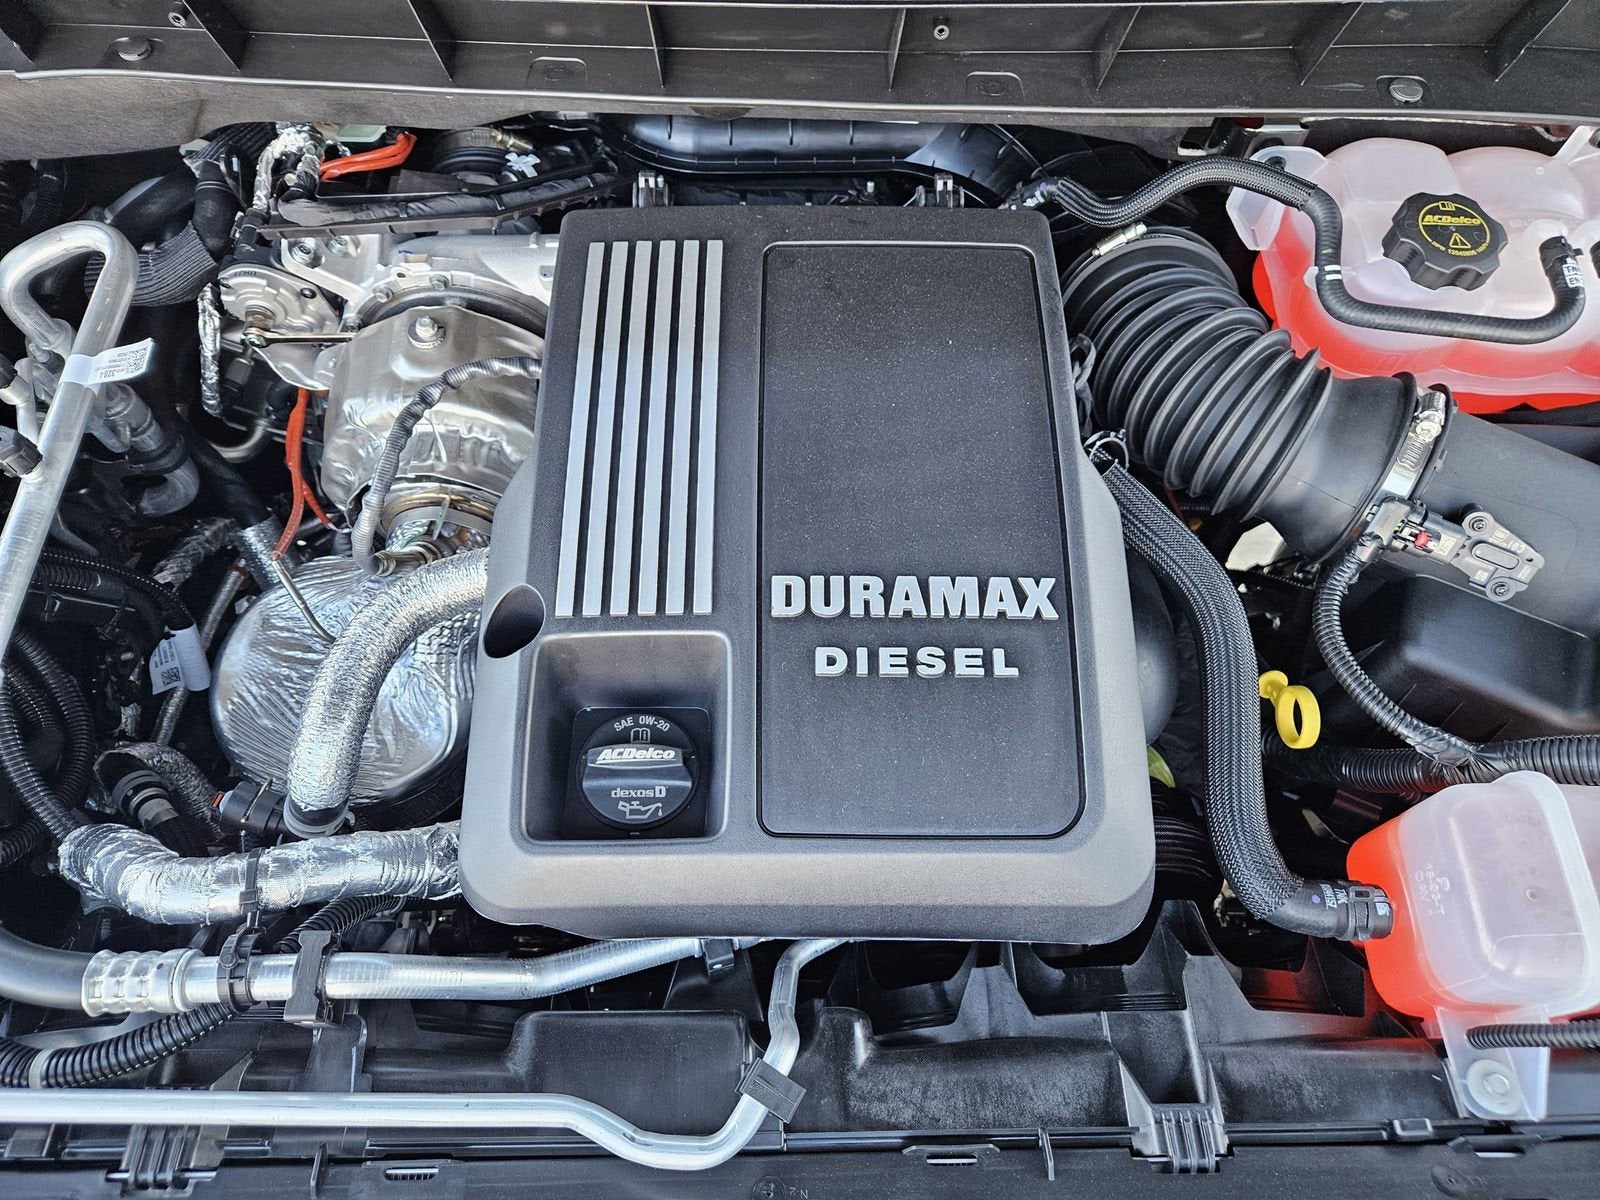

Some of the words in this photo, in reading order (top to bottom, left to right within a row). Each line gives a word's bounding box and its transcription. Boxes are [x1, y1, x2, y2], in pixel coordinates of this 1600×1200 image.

[1422, 214, 1481, 226] ACDelco
[771, 575, 1060, 621] DURAMAX
[814, 646, 1020, 679] DIESEL
[613, 716, 635, 732] SAE
[638, 715, 671, 732] 0W-20
[596, 747, 676, 763] ACDelco
